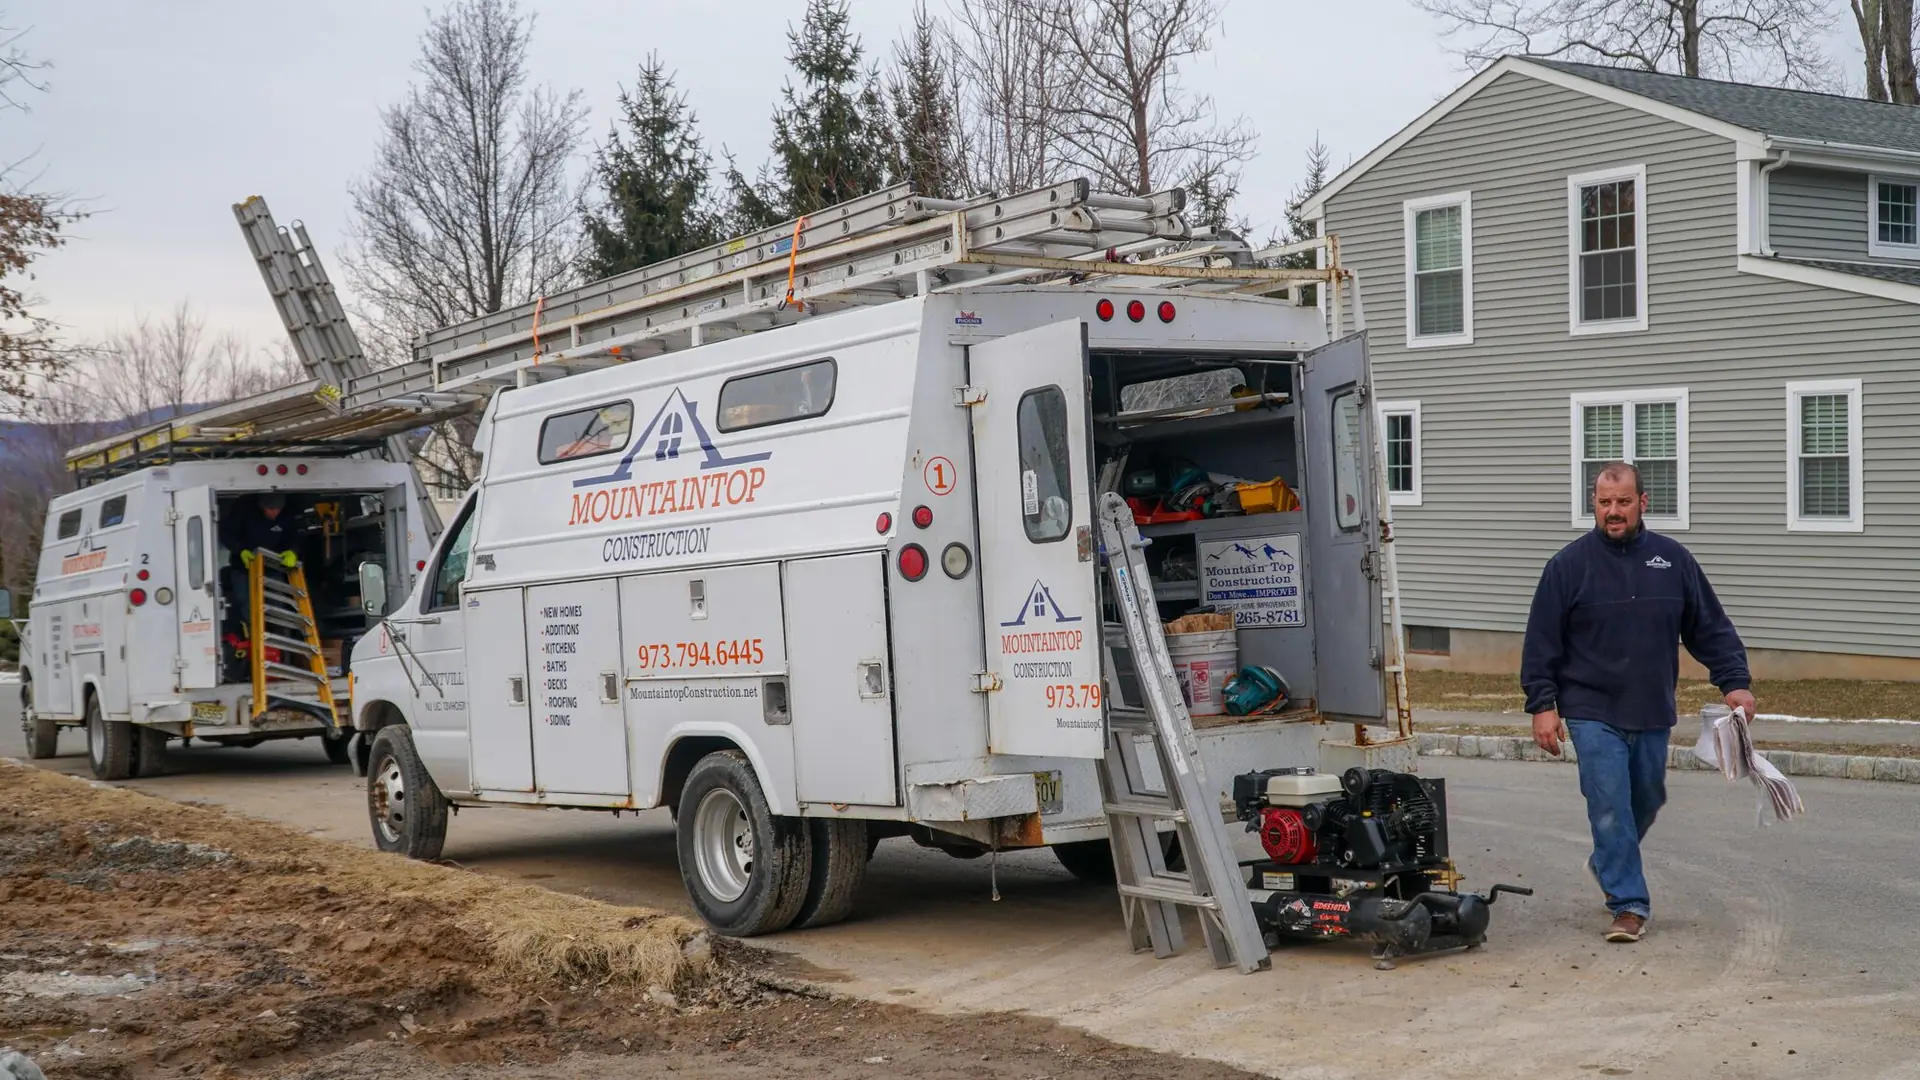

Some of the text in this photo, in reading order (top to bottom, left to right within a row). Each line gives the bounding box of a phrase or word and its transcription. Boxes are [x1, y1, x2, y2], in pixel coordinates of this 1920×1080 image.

[933, 464, 947, 488] 1
[568, 467, 766, 525] MOUNTAINTOP
[603, 527, 711, 562] CONSTRUCTION
[141, 553, 149, 565] 2
[1205, 562, 1295, 576] Mountain Top
[1210, 575, 1291, 588] Construction
[1208, 592, 1227, 600] Don't
[1241, 602, 1255, 610] HOME
[1257, 600, 1297, 609] IMPROVEMENTS
[543, 606, 582, 618] NEW HOMES
[1236, 610, 1300, 624] 265-8781
[545, 624, 579, 636] ADDITIONS
[545, 642, 576, 655] KITCHENS
[1001, 631, 1083, 654] MOUNTAINTOP
[638, 639, 764, 669] 973.794.6445
[546, 661, 567, 672] BATHS
[1013, 662, 1072, 678] CONSTRUCTION
[547, 679, 567, 690] DECKS
[630, 686, 758, 701] MountaintopConstruction.net
[1046, 685, 1101, 708] 973.79
[548, 697, 577, 708] ROOFING
[549, 715, 571, 726] SIDING
